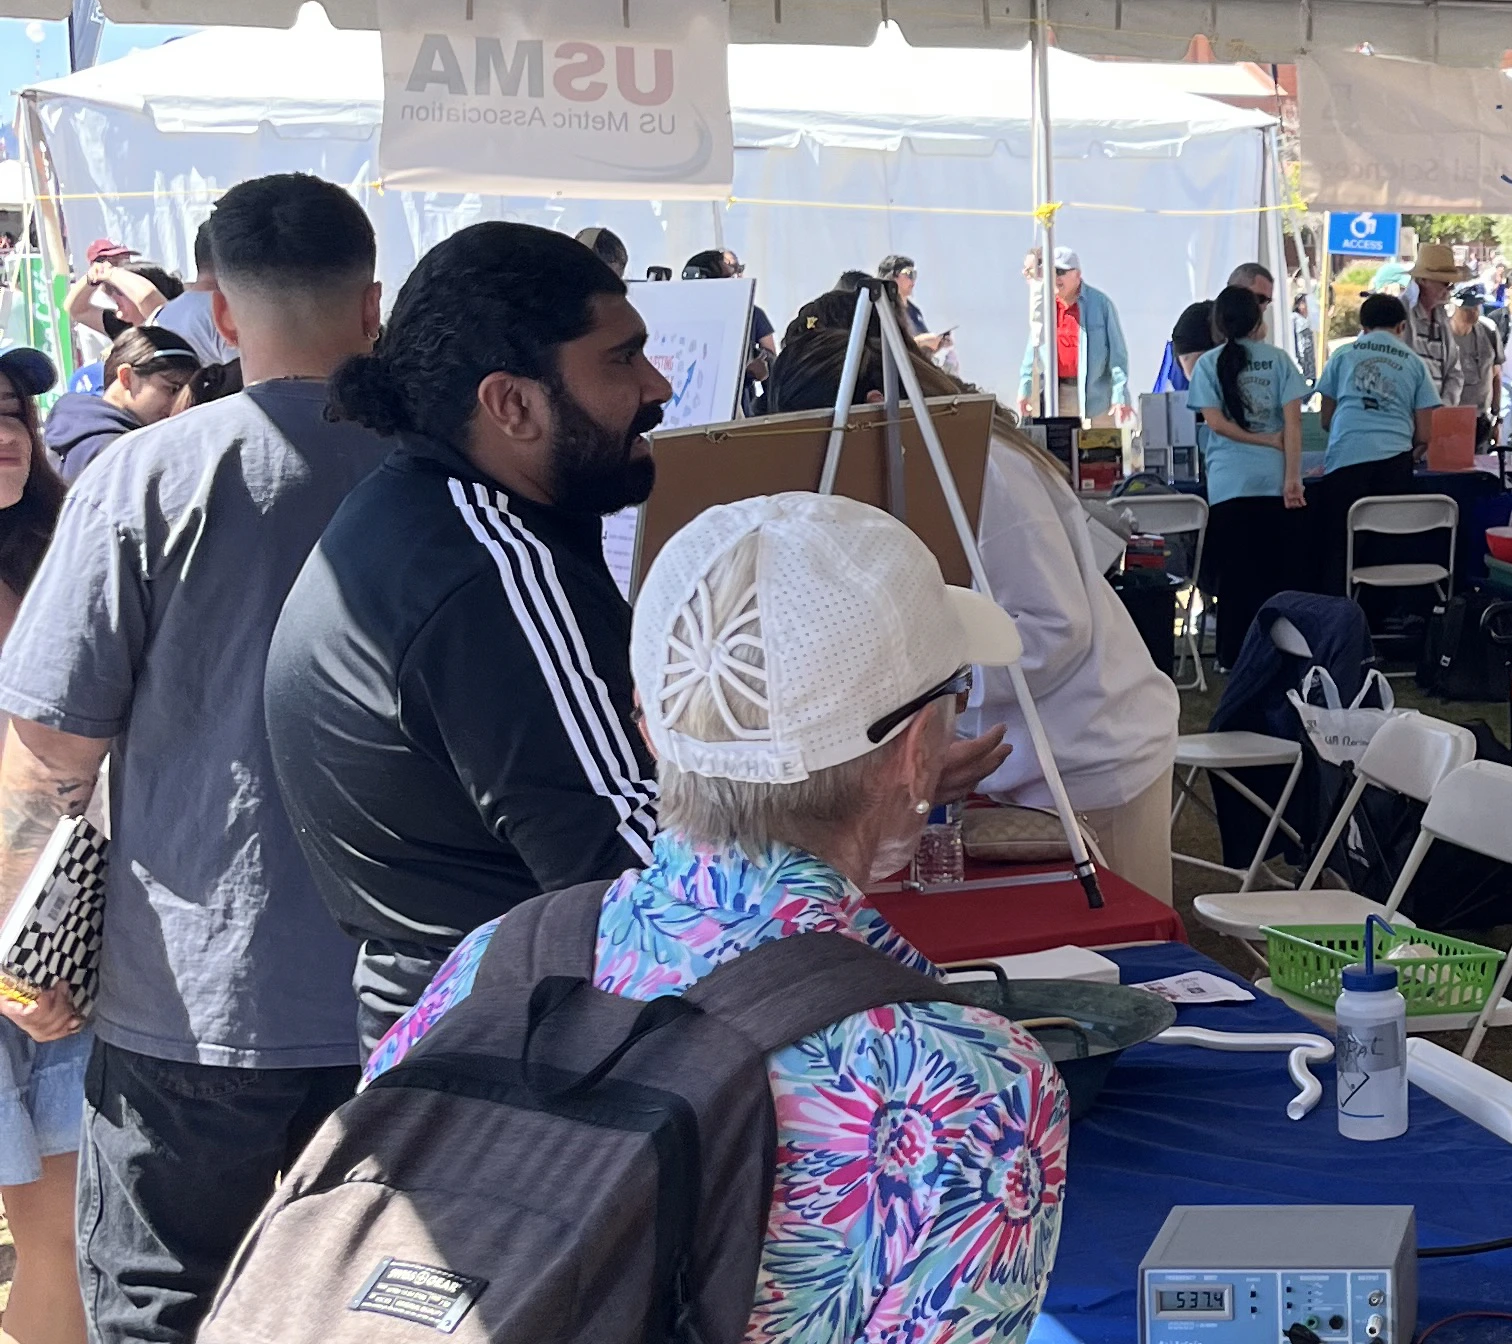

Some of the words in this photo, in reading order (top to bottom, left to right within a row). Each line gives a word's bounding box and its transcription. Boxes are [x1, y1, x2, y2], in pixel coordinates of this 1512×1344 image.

[1342, 239, 1384, 251] ACCESS
[692, 752, 796, 778] VIMHUE
[1176, 1290, 1225, 1309] 537.4
